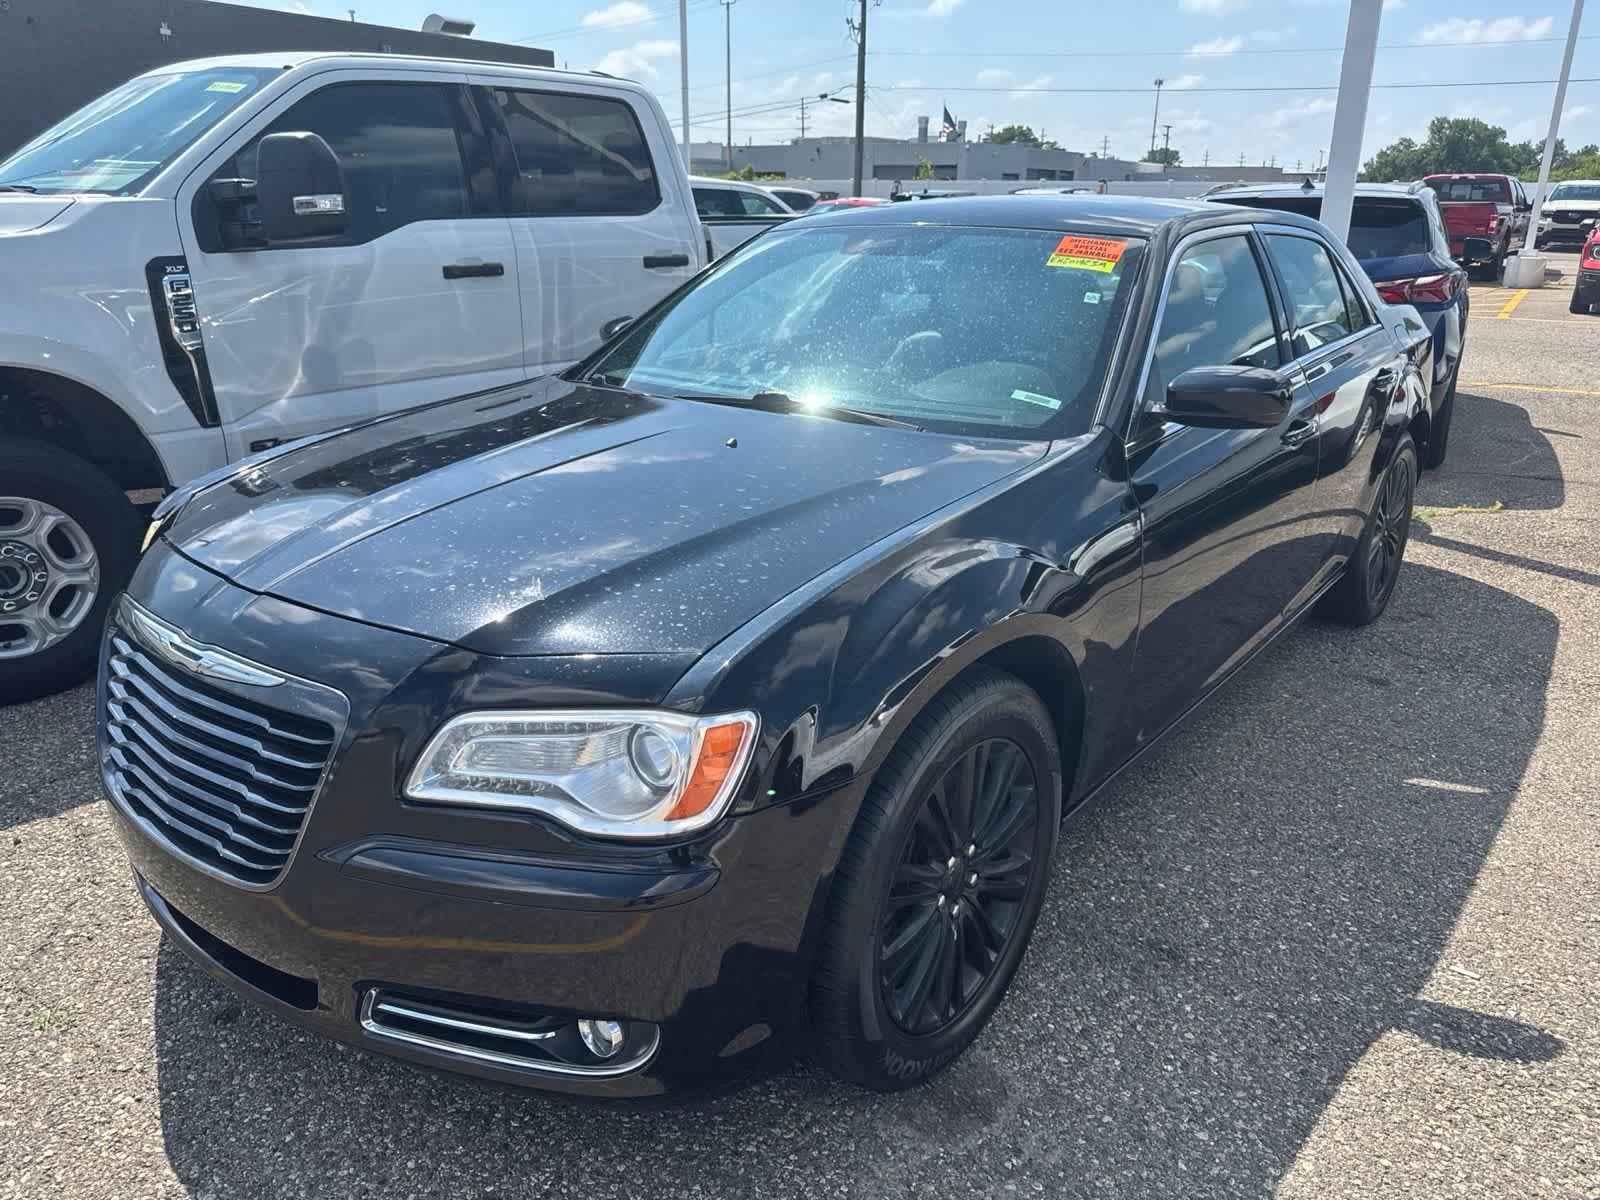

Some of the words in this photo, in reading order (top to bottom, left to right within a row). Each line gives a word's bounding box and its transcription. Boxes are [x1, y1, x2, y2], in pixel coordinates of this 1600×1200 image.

[1074, 244, 1108, 252] SPECIAL
[1075, 248, 1119, 260] MANAGER
[165, 265, 185, 273] XLT
